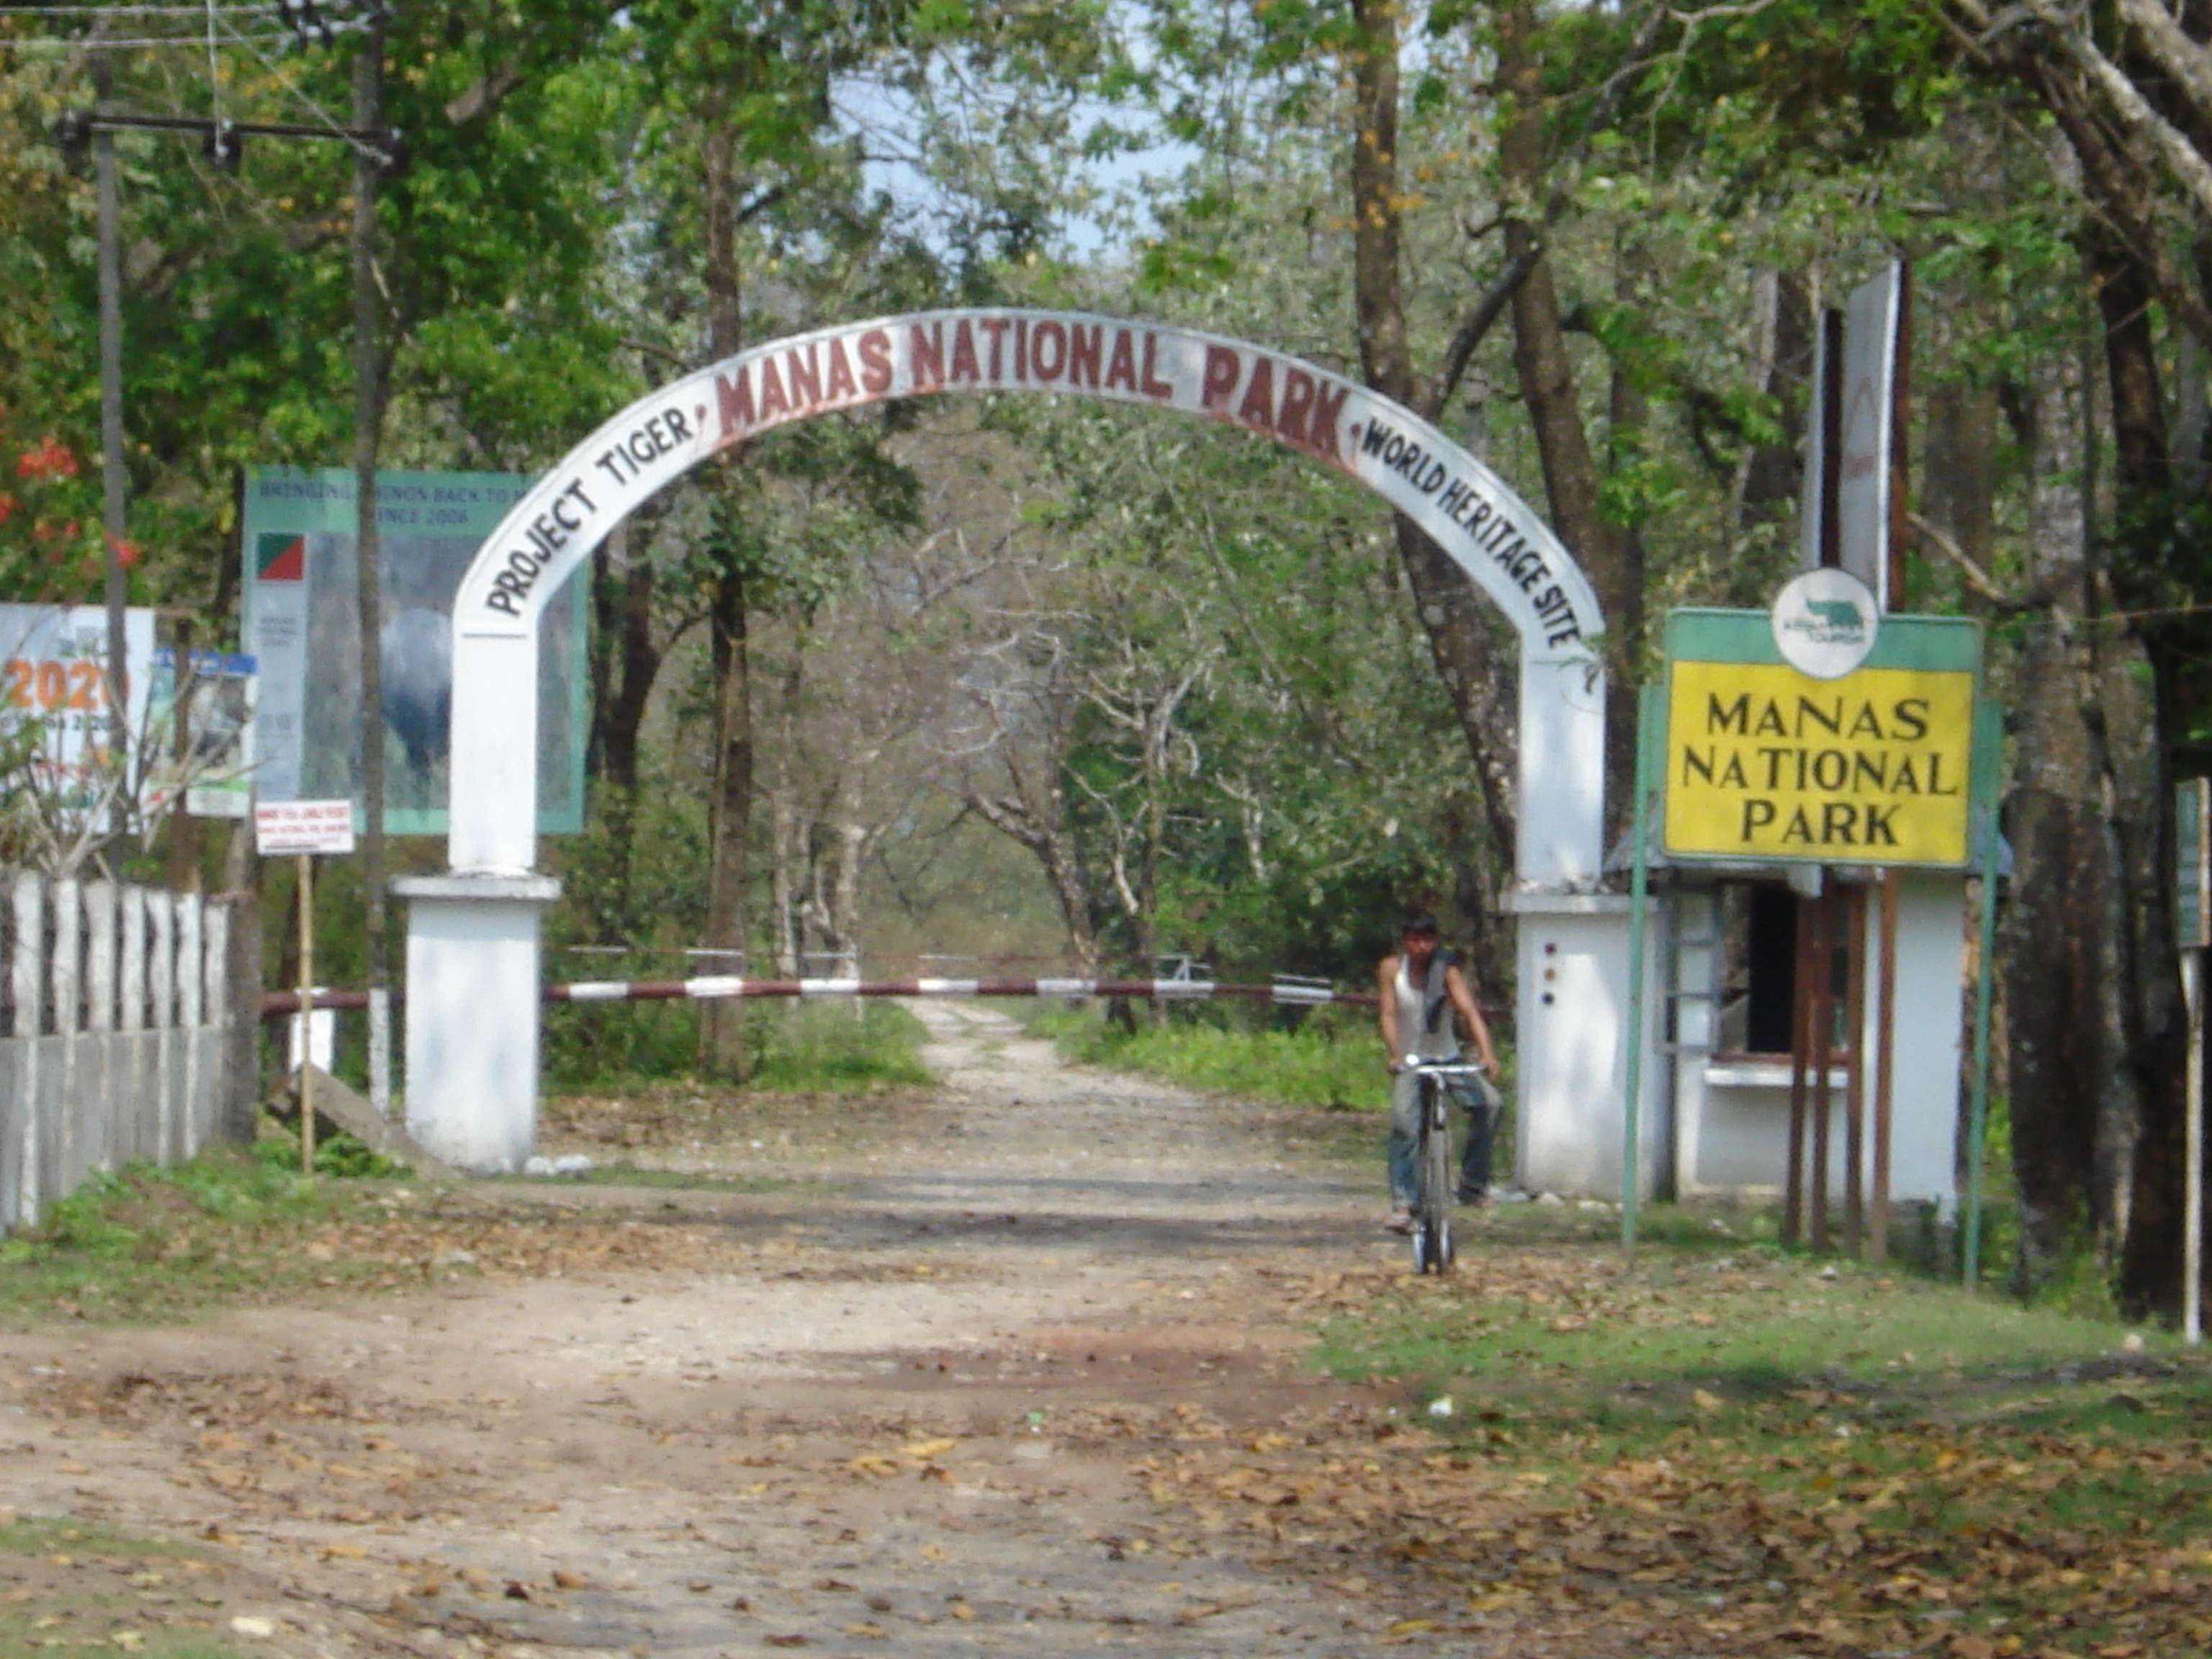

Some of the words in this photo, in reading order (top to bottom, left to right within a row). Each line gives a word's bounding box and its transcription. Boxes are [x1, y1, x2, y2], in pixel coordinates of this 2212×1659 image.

[715, 328, 894, 438] MANAS
[908, 319, 1172, 400] NATIONAL
[1202, 343, 1349, 455] PARK
[376, 506, 418, 524] INCE
[433, 486, 479, 503] BACK
[487, 477, 598, 616] PROJECT
[595, 407, 693, 486] TIGER
[1362, 418, 1446, 494] WORLD
[1437, 478, 1552, 595] HERITAGE
[1532, 584, 1581, 648] SITE
[1707, 691, 1931, 742] MANAS
[1683, 745, 1958, 796] NATIONAL
[1740, 799, 1902, 847] PARK
